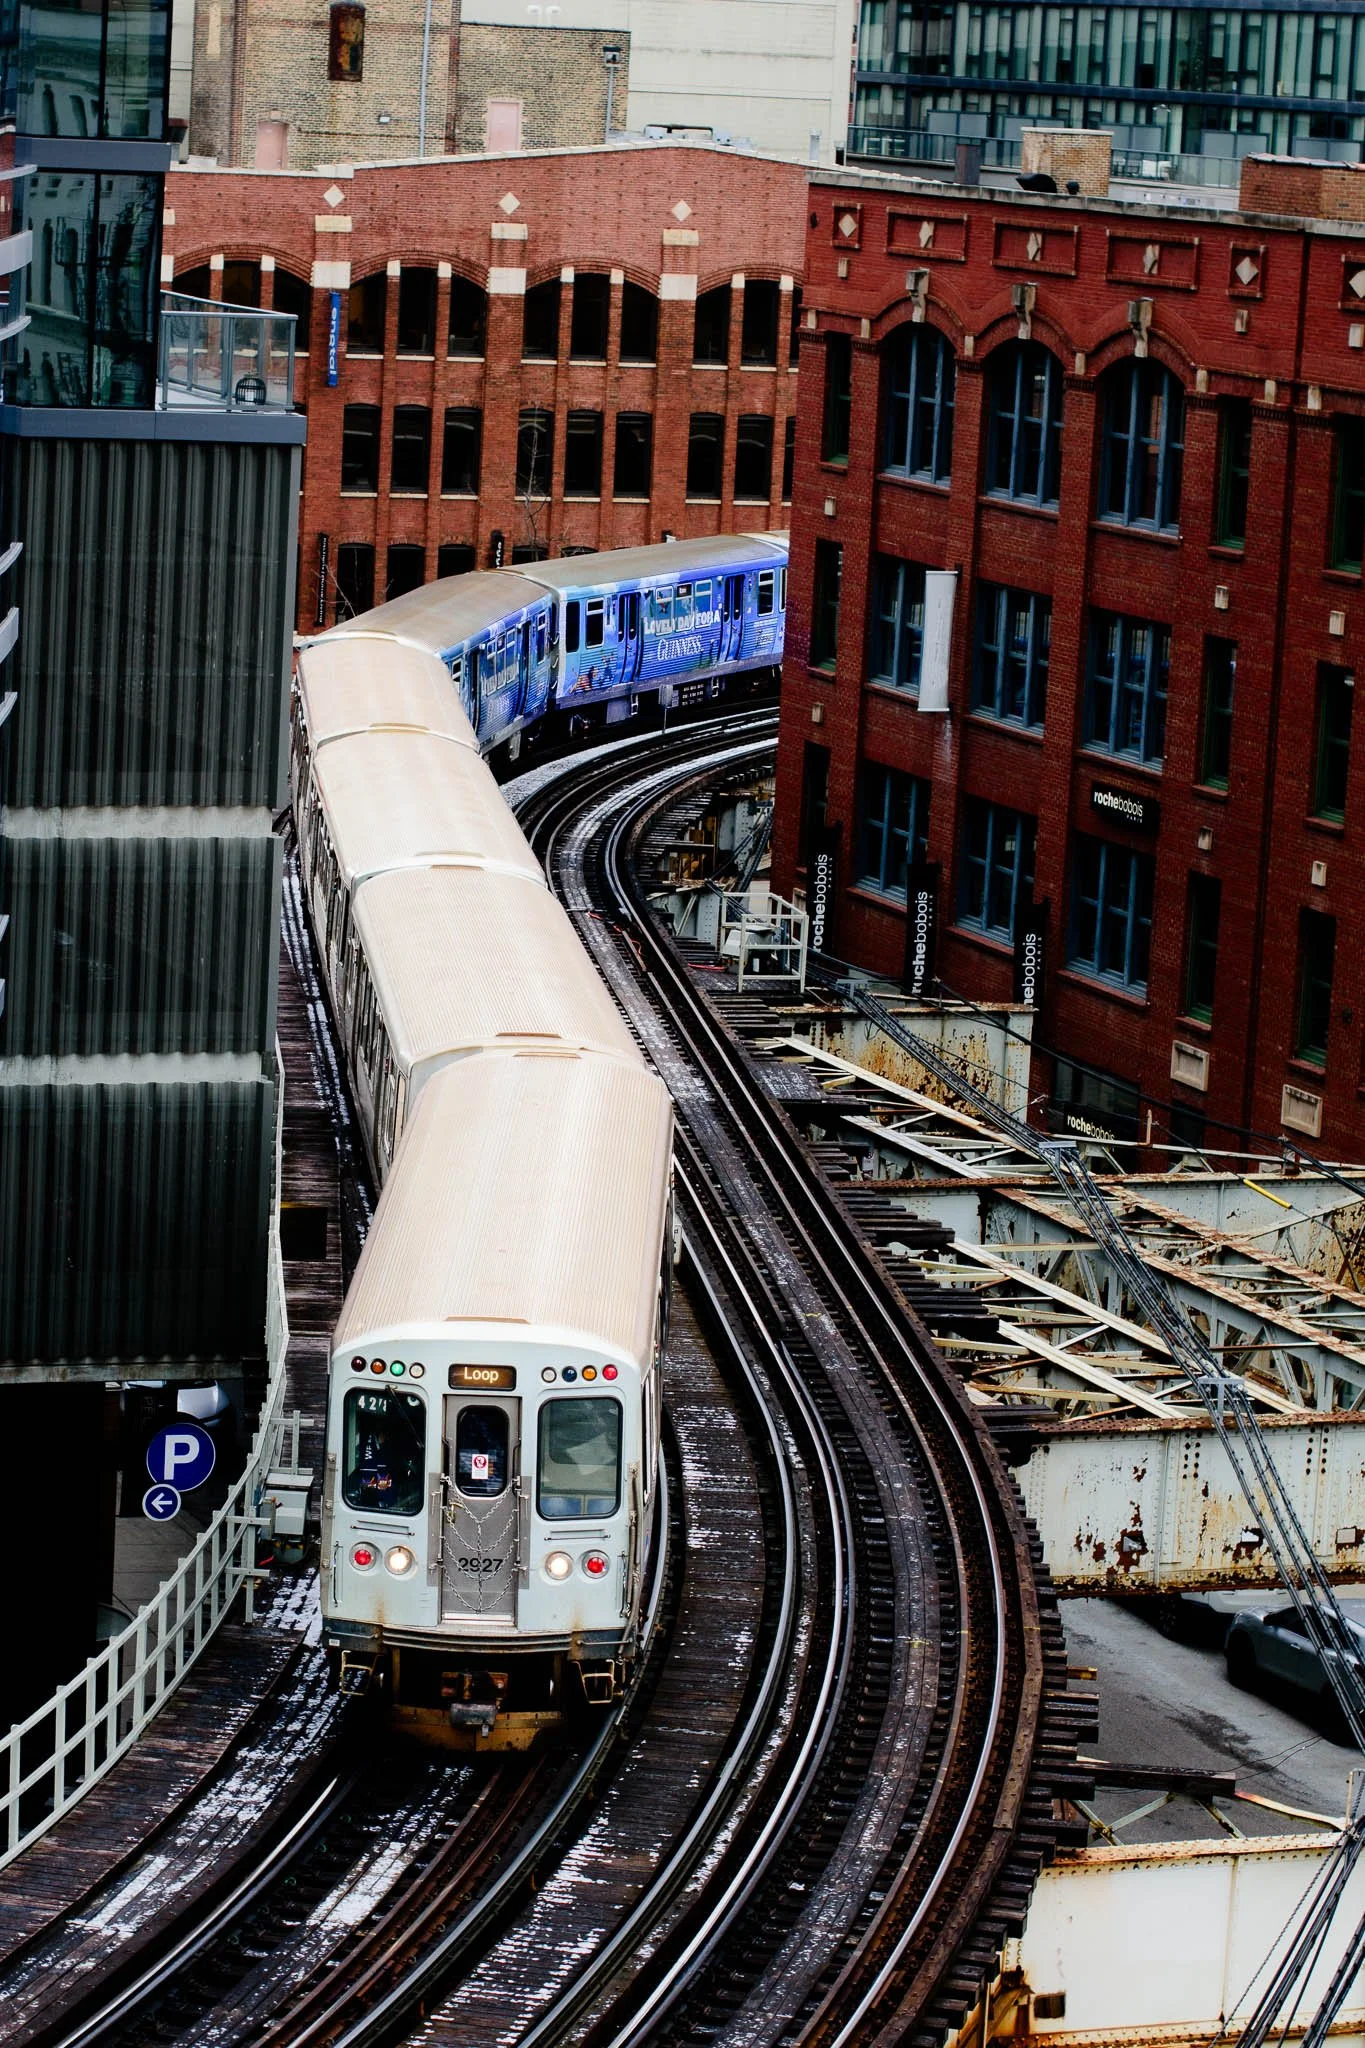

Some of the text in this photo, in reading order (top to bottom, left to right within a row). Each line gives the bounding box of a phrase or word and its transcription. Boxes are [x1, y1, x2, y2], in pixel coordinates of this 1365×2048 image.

[1093, 791, 1144, 817] rochebobois
[464, 1366, 499, 1383] Loop
[163, 1434, 200, 1481] P
[458, 1557, 504, 1573] 2927
